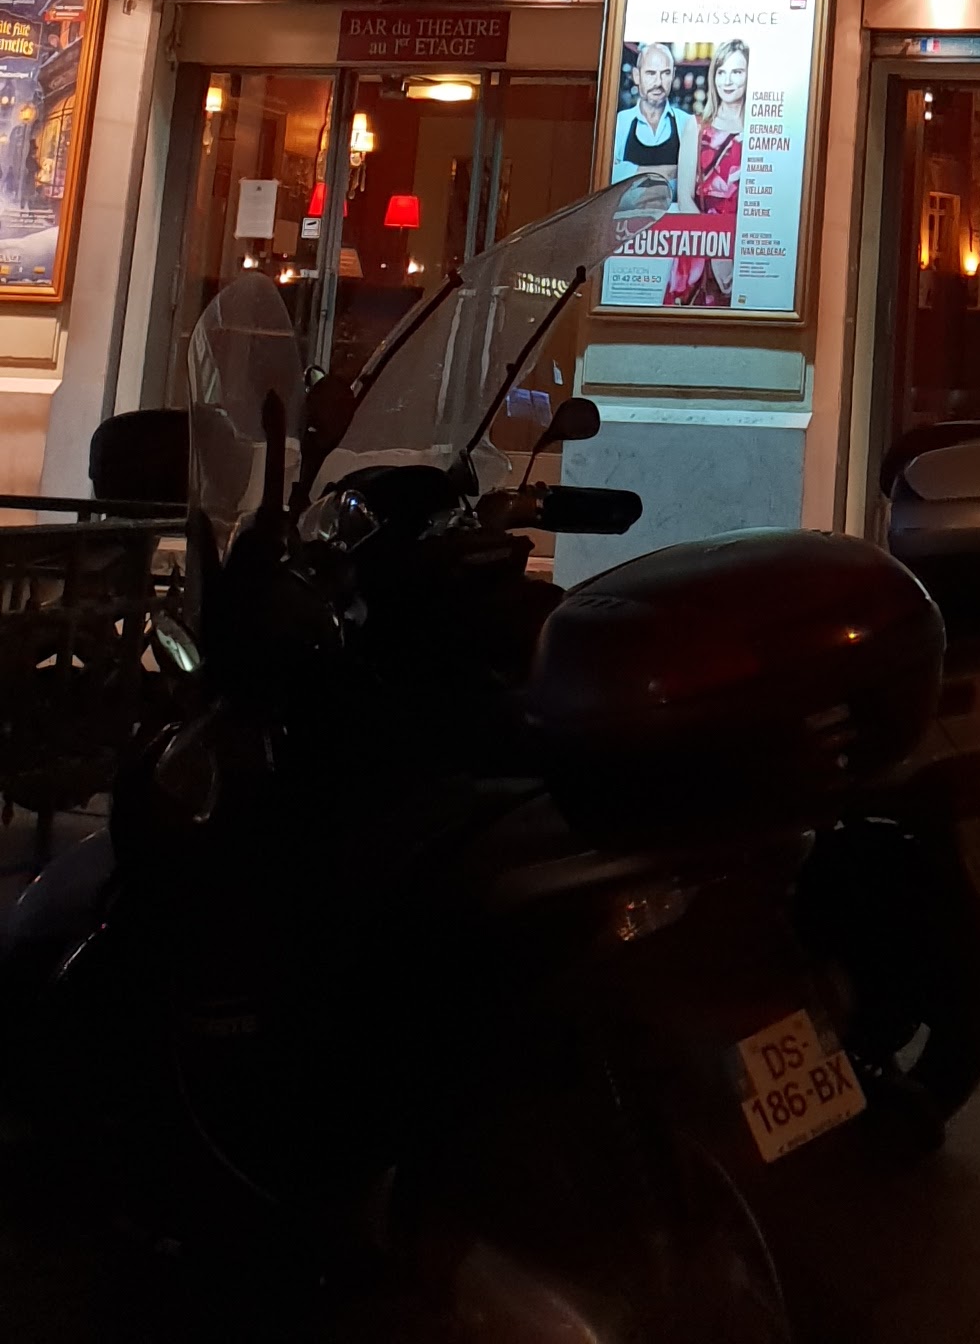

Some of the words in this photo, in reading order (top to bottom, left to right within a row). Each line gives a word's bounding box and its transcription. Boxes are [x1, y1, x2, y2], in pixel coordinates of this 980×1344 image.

[660, 10, 781, 26] RENAISSANCE
[349, 18, 387, 36] BAR
[392, 19, 412, 36] du
[416, 18, 501, 37] THEATRE
[368, 40, 387, 55] au
[414, 38, 476, 56] ETAGE
[751, 91, 785, 104] ISABELLE
[750, 102, 784, 118] CARRÉ
[749, 123, 784, 136] BERNARD
[748, 136, 790, 151] CAMPAN
[751, 1055, 853, 1134] 186-BX
